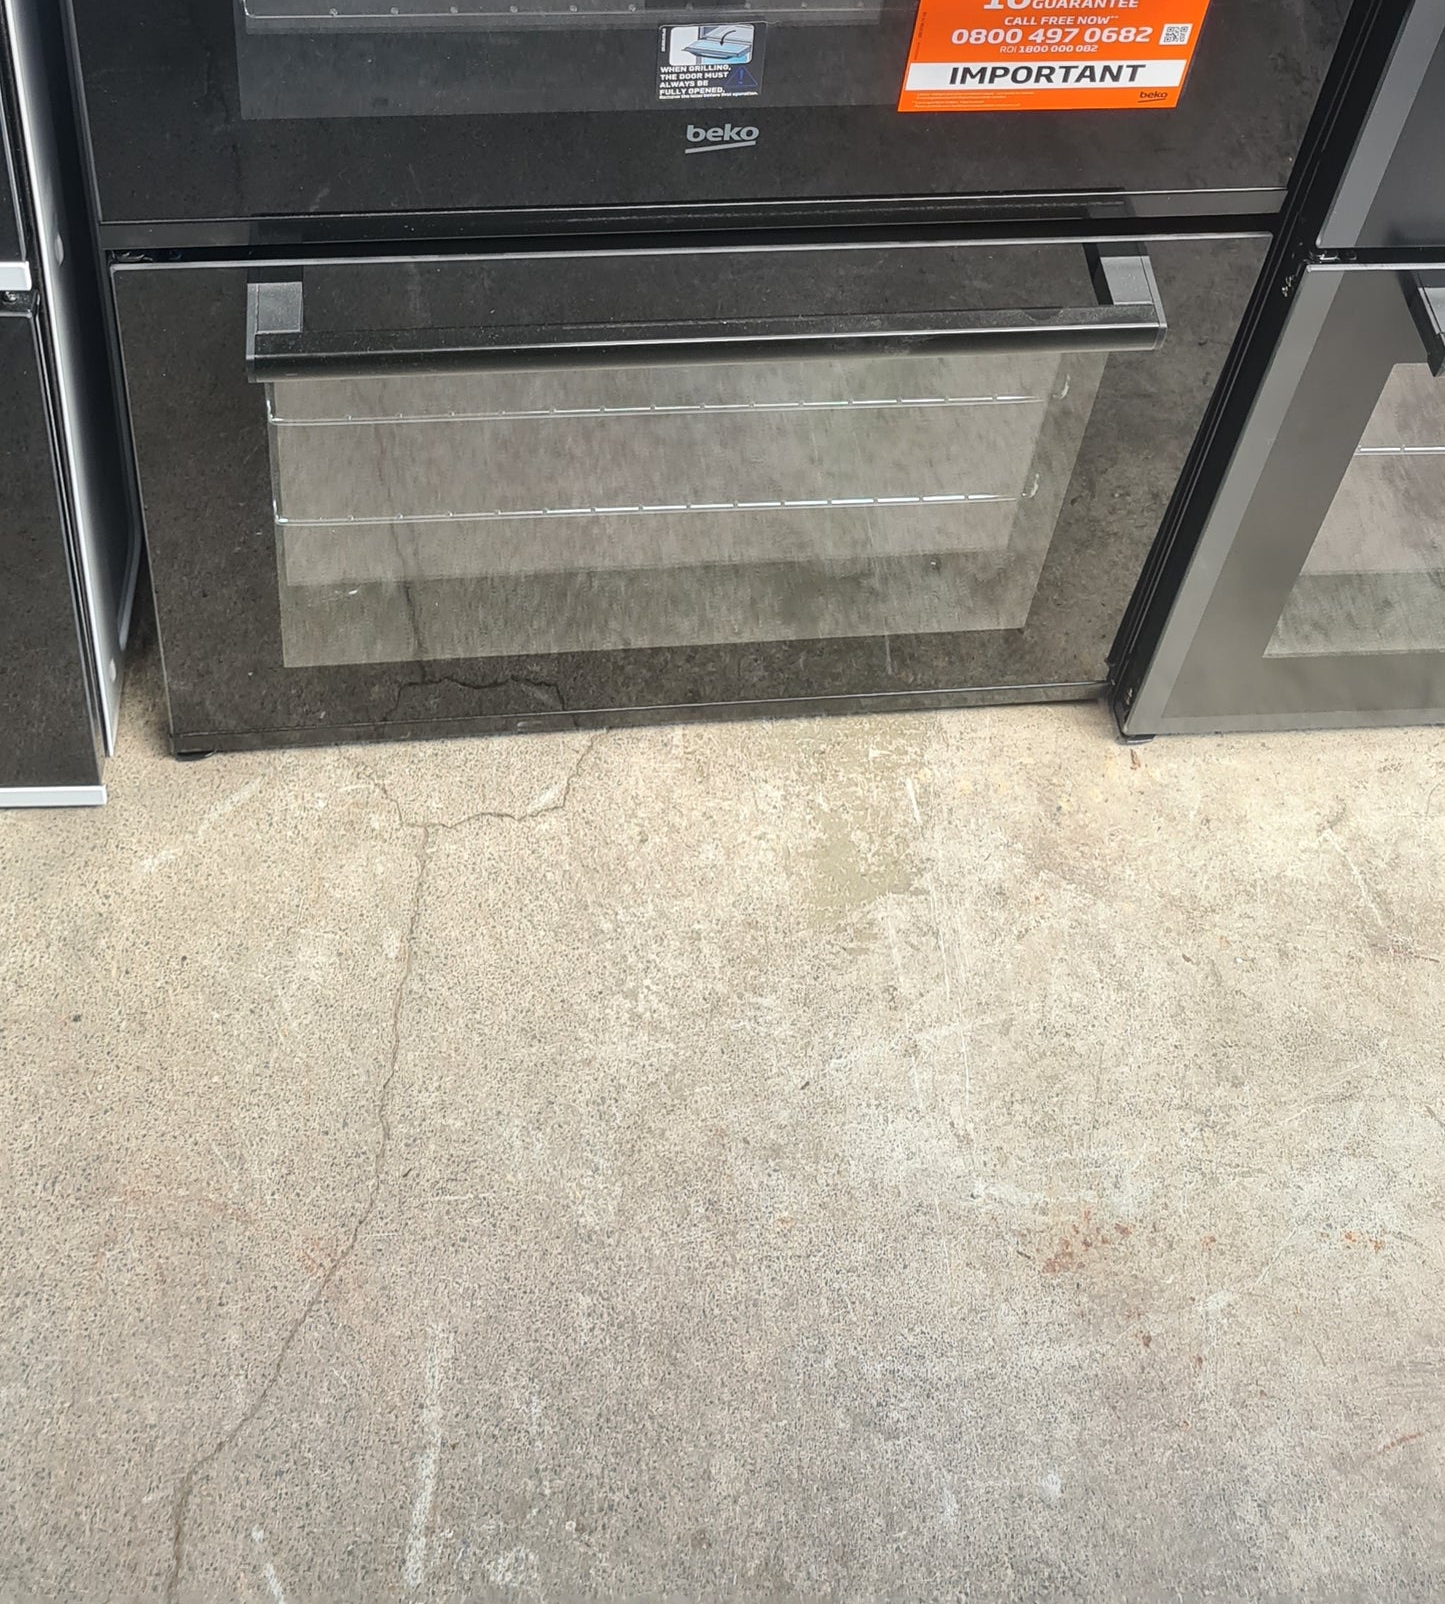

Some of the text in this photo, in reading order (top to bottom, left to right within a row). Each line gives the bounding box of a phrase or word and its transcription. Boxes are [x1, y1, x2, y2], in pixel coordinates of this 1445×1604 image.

[1004, 16, 1038, 26] CALL
[1041, 16, 1075, 25] FREE
[951, 27, 1154, 45] 0800 497 0682
[999, 44, 1099, 54] ROI 1800 000 082
[660, 65, 687, 73] WHEN
[949, 64, 1146, 84] IMPORTANT
[679, 72, 703, 80] DOOR
[659, 80, 695, 88] ALWAYS
[1139, 91, 1168, 99] beko
[686, 124, 760, 142] beko
